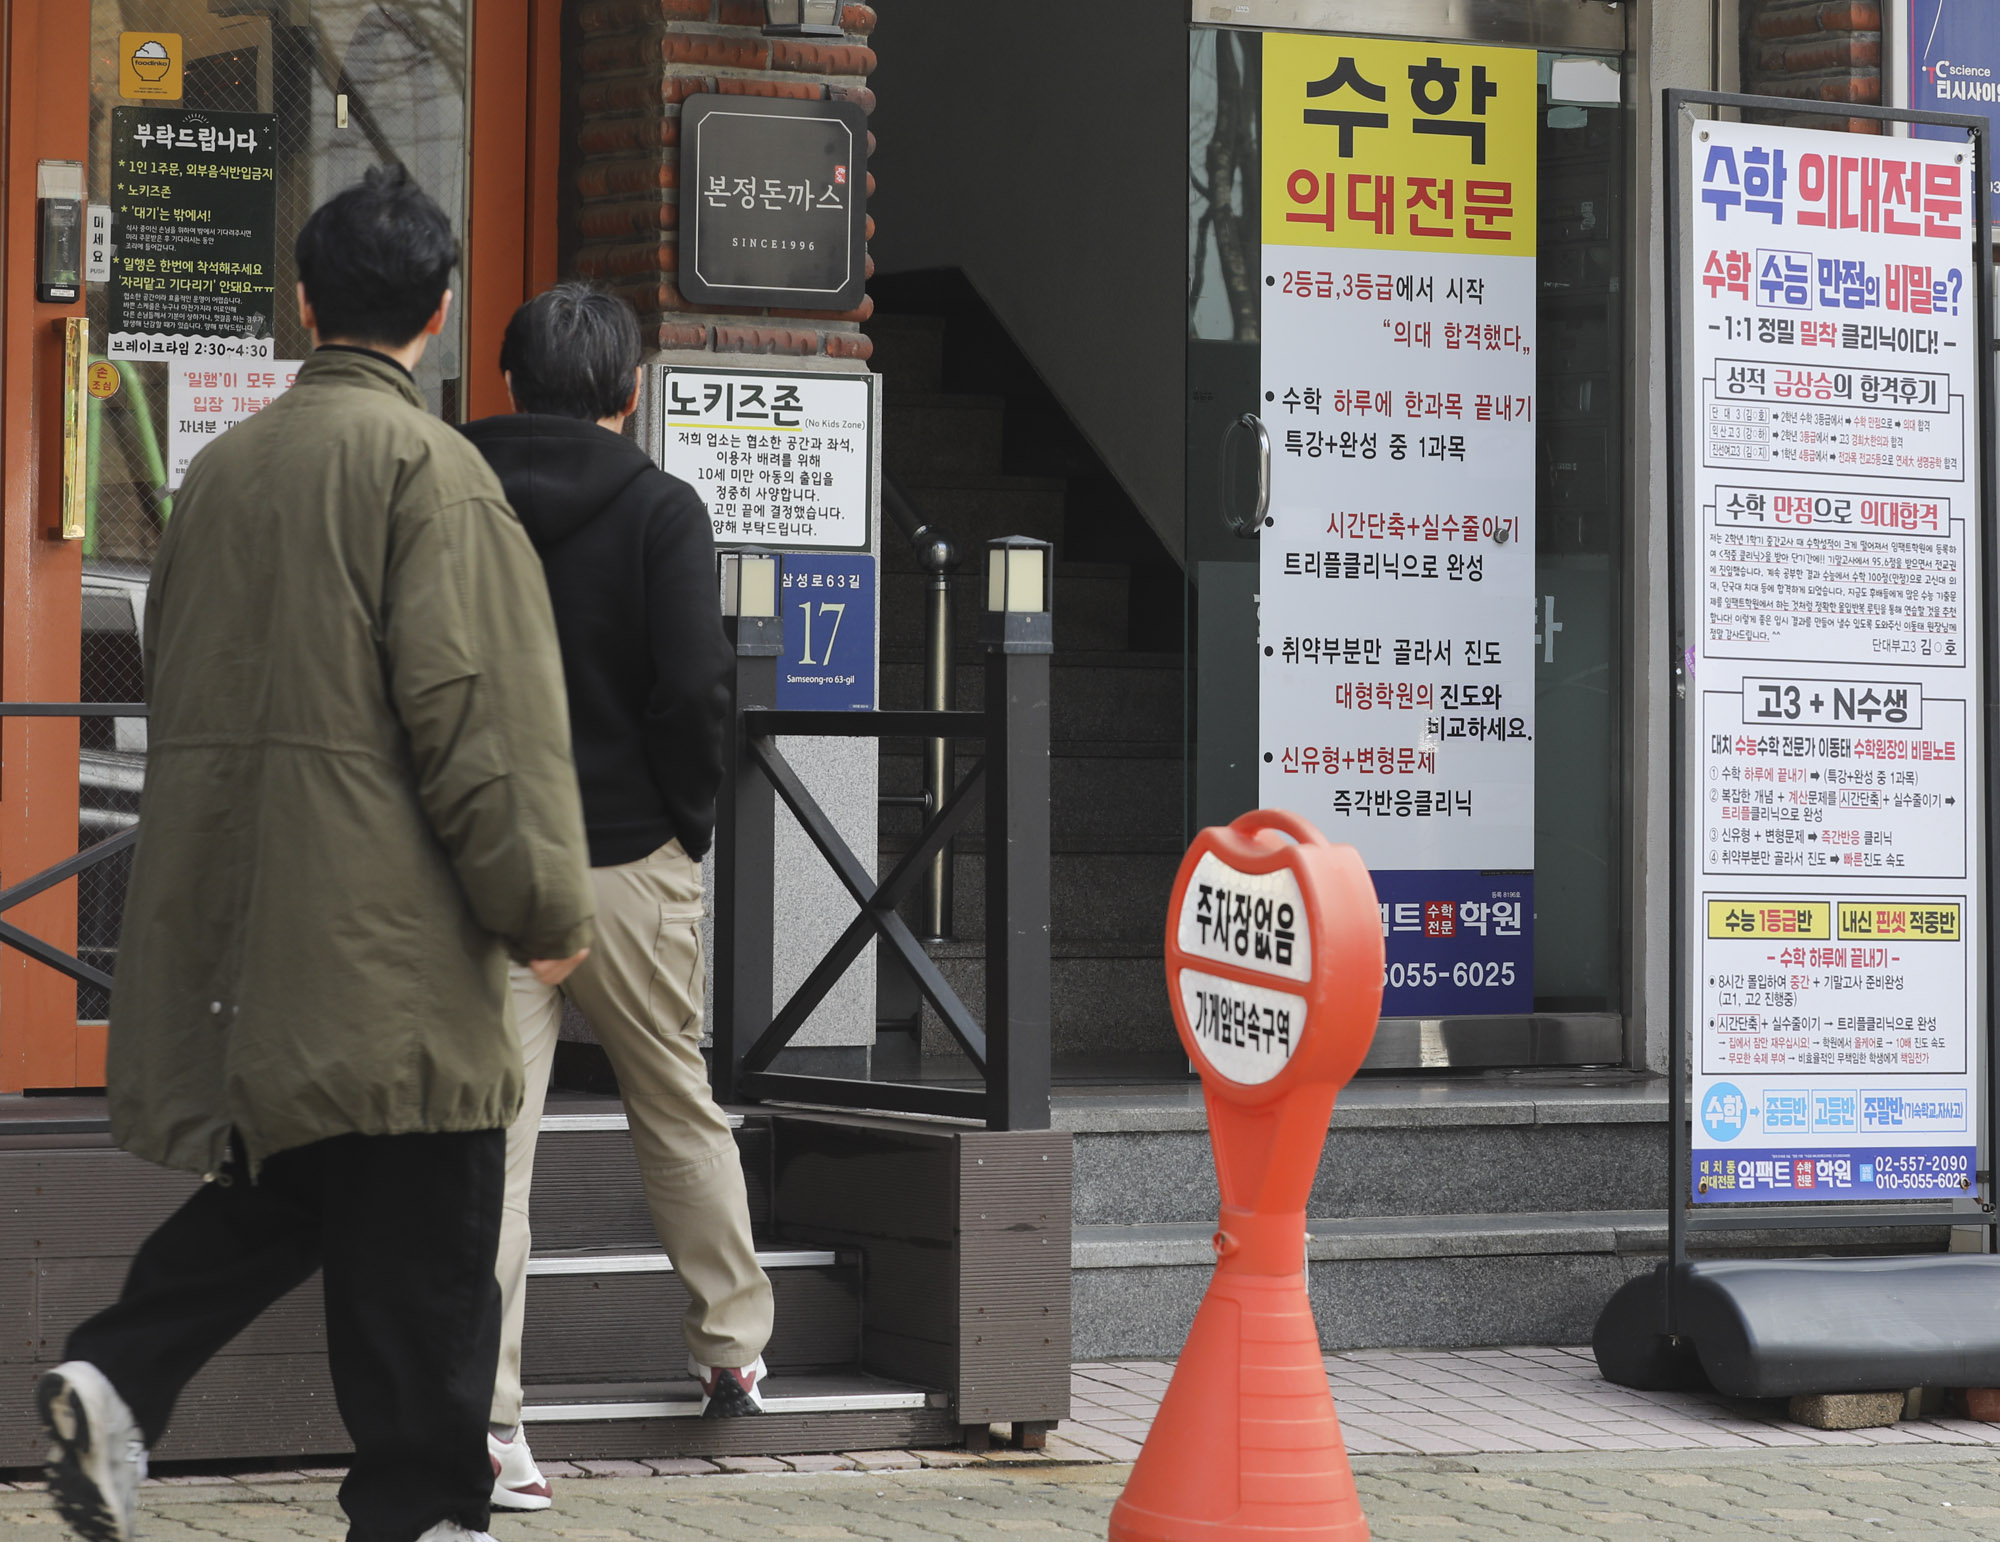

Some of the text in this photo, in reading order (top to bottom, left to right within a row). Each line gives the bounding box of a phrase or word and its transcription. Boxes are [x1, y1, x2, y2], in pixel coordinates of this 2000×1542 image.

[1949, 65, 1991, 77] science
[1303, 56, 1498, 165] 수학
[133, 123, 258, 154] 부탁드립니다
[129, 161, 273, 181] 1인 1주문, 외부음식반입금지
[128, 184, 171, 199] 노키즈존
[704, 175, 844, 212] 본정돈까스
[1285, 168, 1514, 241] 의대전문
[1702, 145, 1962, 240] 수학 의대전문
[173, 209, 211, 222] 밖에서!
[93, 216, 103, 262] 미세요
[732, 237, 815, 251] SINCE1996
[123, 257, 263, 276] 일행은 한번에 착석해주세요
[1282, 269, 1485, 305] 2등급,3등급에서 시작
[1702, 249, 1963, 316] 수학 수능 만점의 비밀은?
[111, 339, 267, 357] 브레이크타임 2:30~4:30
[1758, 317, 1795, 345] 정밀
[1800, 320, 1837, 348] 밀착
[1841, 323, 1939, 355] 클리닉이다!
[96, 367, 109, 379] 손
[246, 373, 276, 388] 모두
[1726, 366, 1937, 406] 성적 급상승의 합격후기
[194, 396, 224, 413] 입장
[667, 381, 803, 427] 노키즈존
[1282, 386, 1532, 423] 수학 하루에 한과목 끝내기
[179, 420, 216, 433] 자녀분
[804, 419, 866, 430] (No Kids Zone)
[678, 432, 854, 453] 저희 업소는 협소한 공간과 좌석,
[1284, 429, 1466, 462] 특강+완성 중 1과목
[716, 451, 821, 468] 이용자 배려를 위해
[697, 468, 834, 486] 10세 미만 아동의 출입을
[716, 485, 820, 502] 정중히 사양합니다.
[713, 503, 845, 521] 고민 끝에 결정했습니다.
[1726, 493, 1938, 531] 수학 만점으로 의대합격
[713, 520, 817, 537] 양해 부탁드립니다.
[1326, 511, 1519, 543] 시간단축+실수줄이기
[1283, 551, 1483, 582] 트리플클리닉으로 완성
[782, 573, 860, 589] 삼성로63길
[798, 601, 846, 666] 17
[1281, 636, 1502, 666] 취약부분만 골라서 진도
[787, 674, 855, 686] Samseong-ro 63-gil
[1335, 682, 1502, 711] 대형학원의 진도와
[1757, 684, 1908, 723] 고3 + N수생
[1428, 715, 1533, 742] 비교하세요.
[1281, 746, 1436, 775] 신유형+변형문제
[1711, 734, 1956, 761] 대치 수능수학 전문가 이동태 수학원장의 비밀노트
[1721, 766, 1741, 781] 수학
[1744, 766, 1774, 782] 하루에
[1777, 767, 1807, 783] 끝내기
[1876, 770, 1887, 785] 중
[1890, 770, 1919, 786] 1과목)
[1333, 789, 1473, 817] 즉각반응클리닉
[1196, 884, 1295, 966] 주차장없음
[1427, 904, 1453, 919] 수학
[1459, 901, 1521, 936] 학원
[1427, 920, 1453, 935] 전문
[1725, 909, 1955, 935] 수능 1등급반 내신 핀셋 적중반
[1780, 947, 1888, 968] 수학 하루에 끝내기
[1718, 974, 1744, 989] 8시간
[1747, 974, 1787, 990] 몰입하여
[1790, 974, 1810, 990] 중간
[1824, 975, 1862, 990] 기말고사
[1865, 975, 1904, 990] 준비완성
[1705, 1094, 1743, 1129] 수학
[1766, 1096, 1807, 1126] 중등반
[1815, 1096, 1855, 1126] 고등반
[1737, 1160, 1792, 1189] 임팩트
[1796, 1161, 1812, 1174] 수학
[1816, 1159, 1852, 1188] 학원
[1875, 1155, 1968, 1172] 02-557-2090
[1796, 1174, 1813, 1187] 전문
